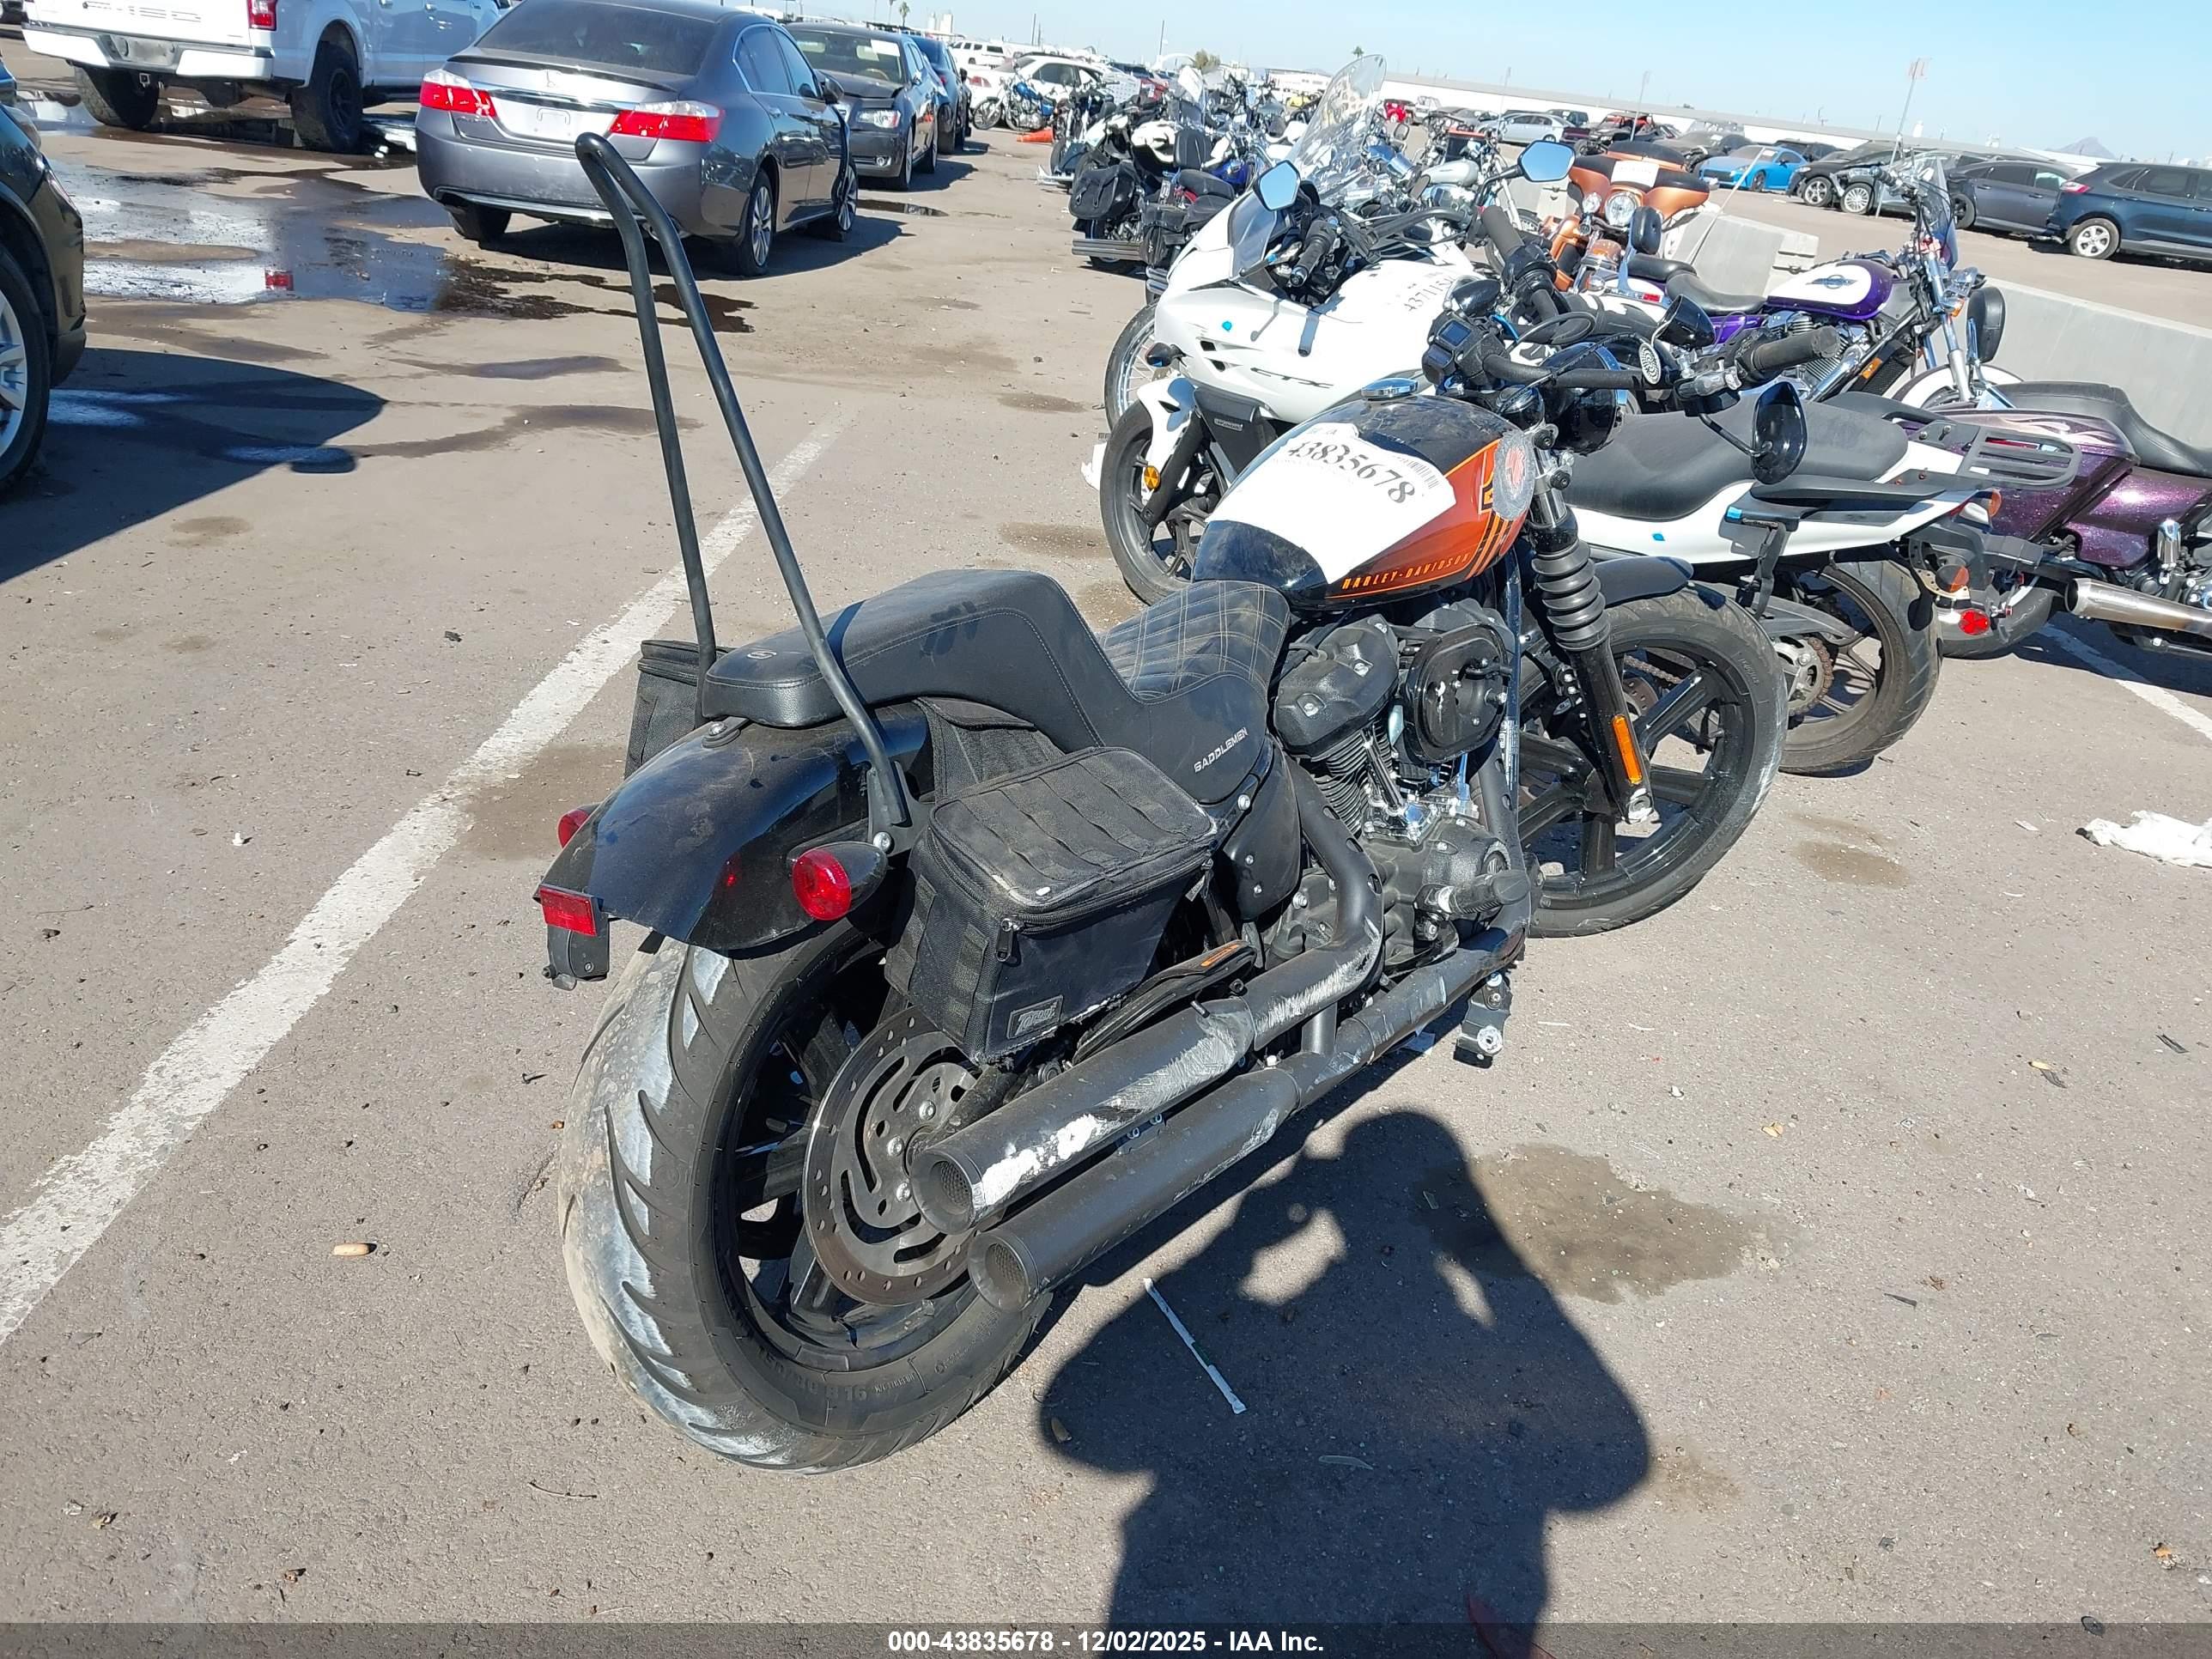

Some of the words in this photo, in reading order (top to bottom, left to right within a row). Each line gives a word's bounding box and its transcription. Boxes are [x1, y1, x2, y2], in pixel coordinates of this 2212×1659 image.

[1287, 441, 1415, 503] 43835678
[1341, 552, 1470, 590] HARLEY-DAVIDSON
[1194, 726, 1249, 773] SADDLEMEN
